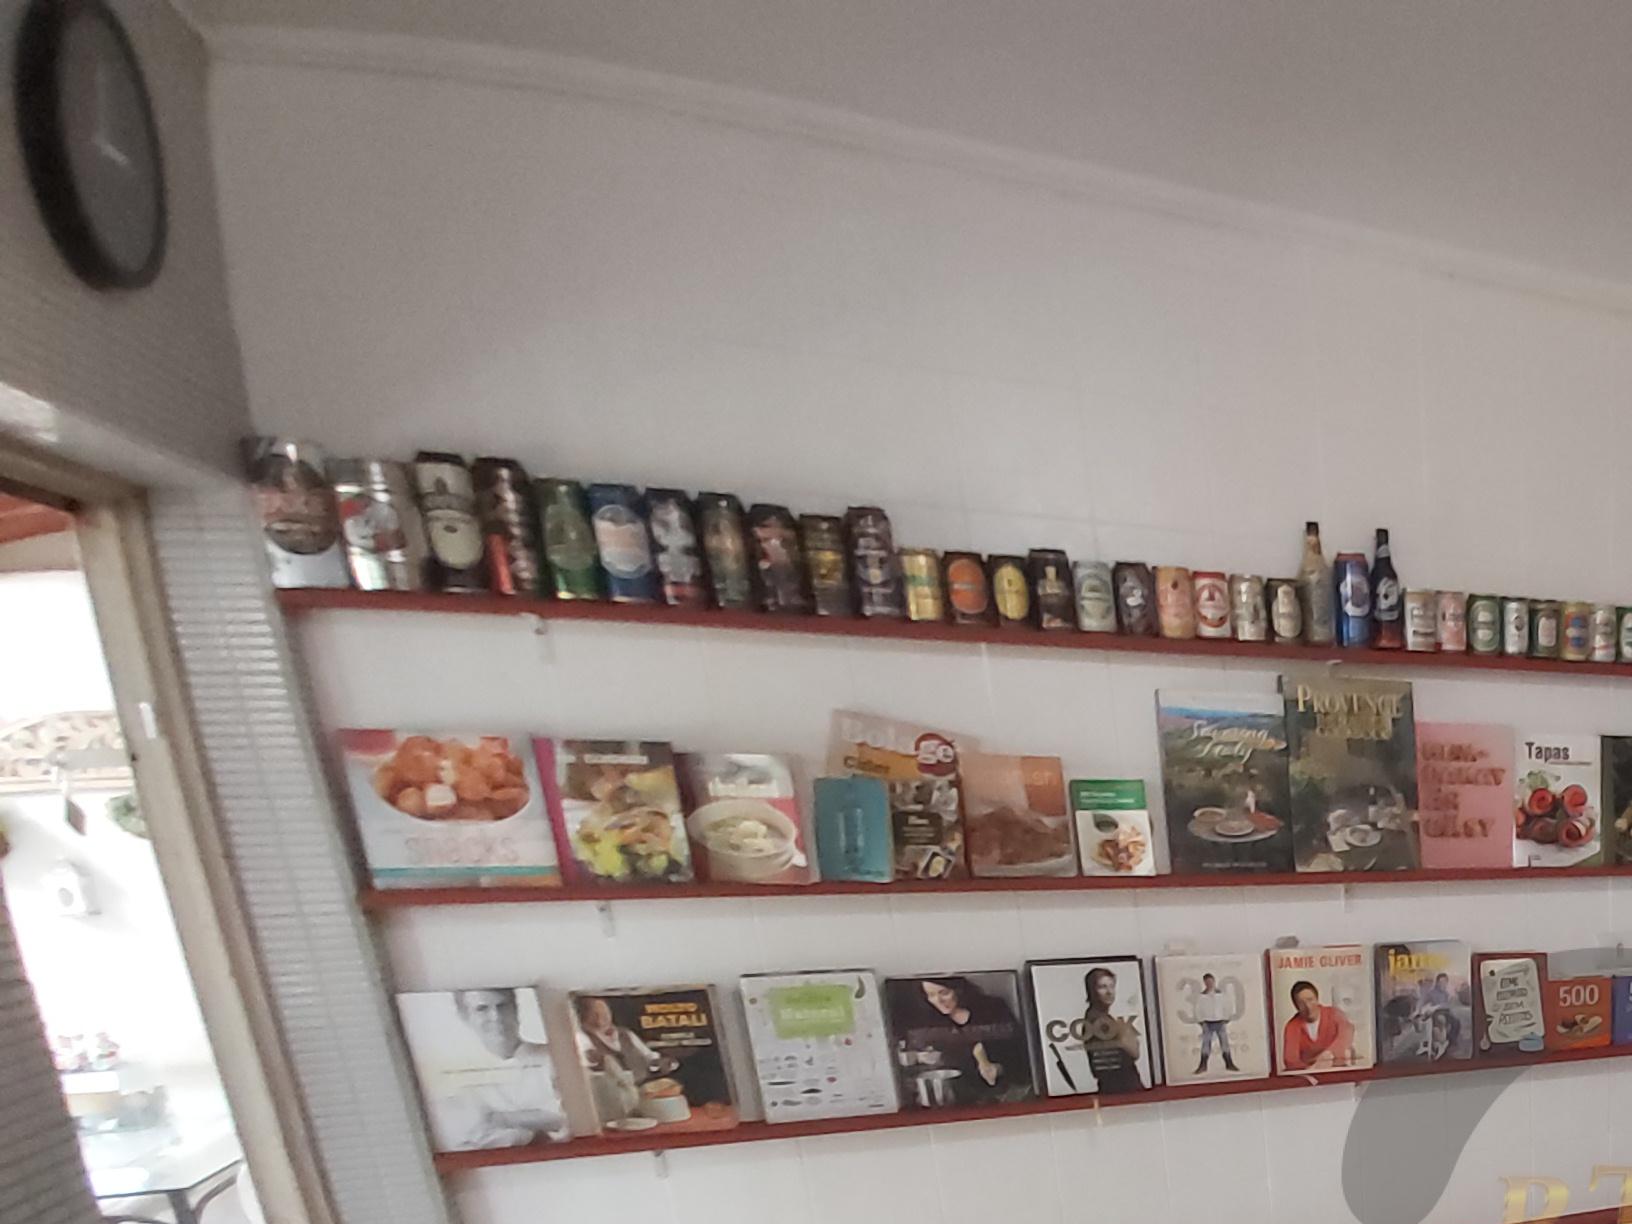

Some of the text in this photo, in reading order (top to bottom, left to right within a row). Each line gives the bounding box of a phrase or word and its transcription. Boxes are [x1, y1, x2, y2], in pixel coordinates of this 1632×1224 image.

[1525, 741, 1571, 763] Tapas
[1276, 953, 1363, 970] JAMIE OLIVER
[1559, 984, 1599, 1007] 500
